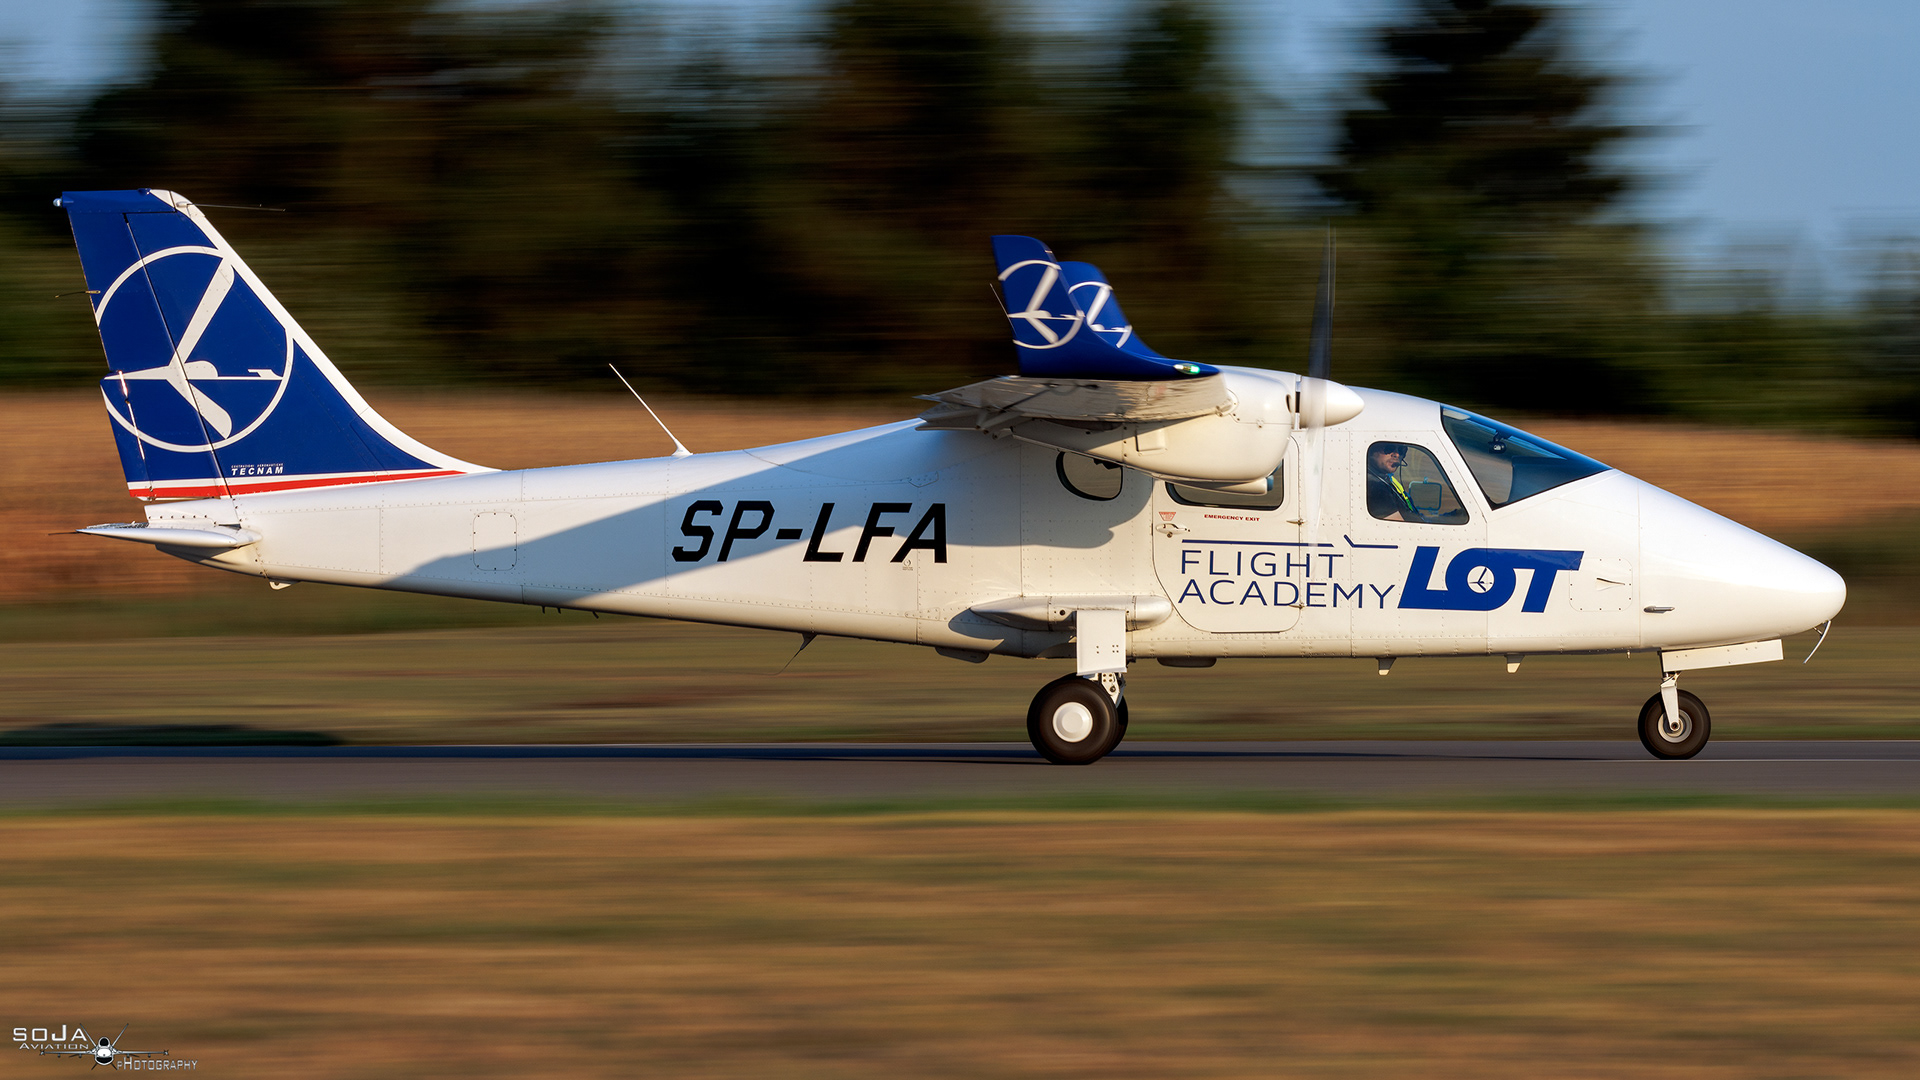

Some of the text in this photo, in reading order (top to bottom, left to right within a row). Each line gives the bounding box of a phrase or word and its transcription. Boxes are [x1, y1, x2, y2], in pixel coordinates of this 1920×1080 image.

[231, 466, 283, 476] TECNAM
[671, 499, 948, 563] SP-LFA
[1181, 549, 1344, 579] FLIGHT
[1178, 579, 1395, 609] ACADEMY
[1397, 546, 1585, 613] LOT
